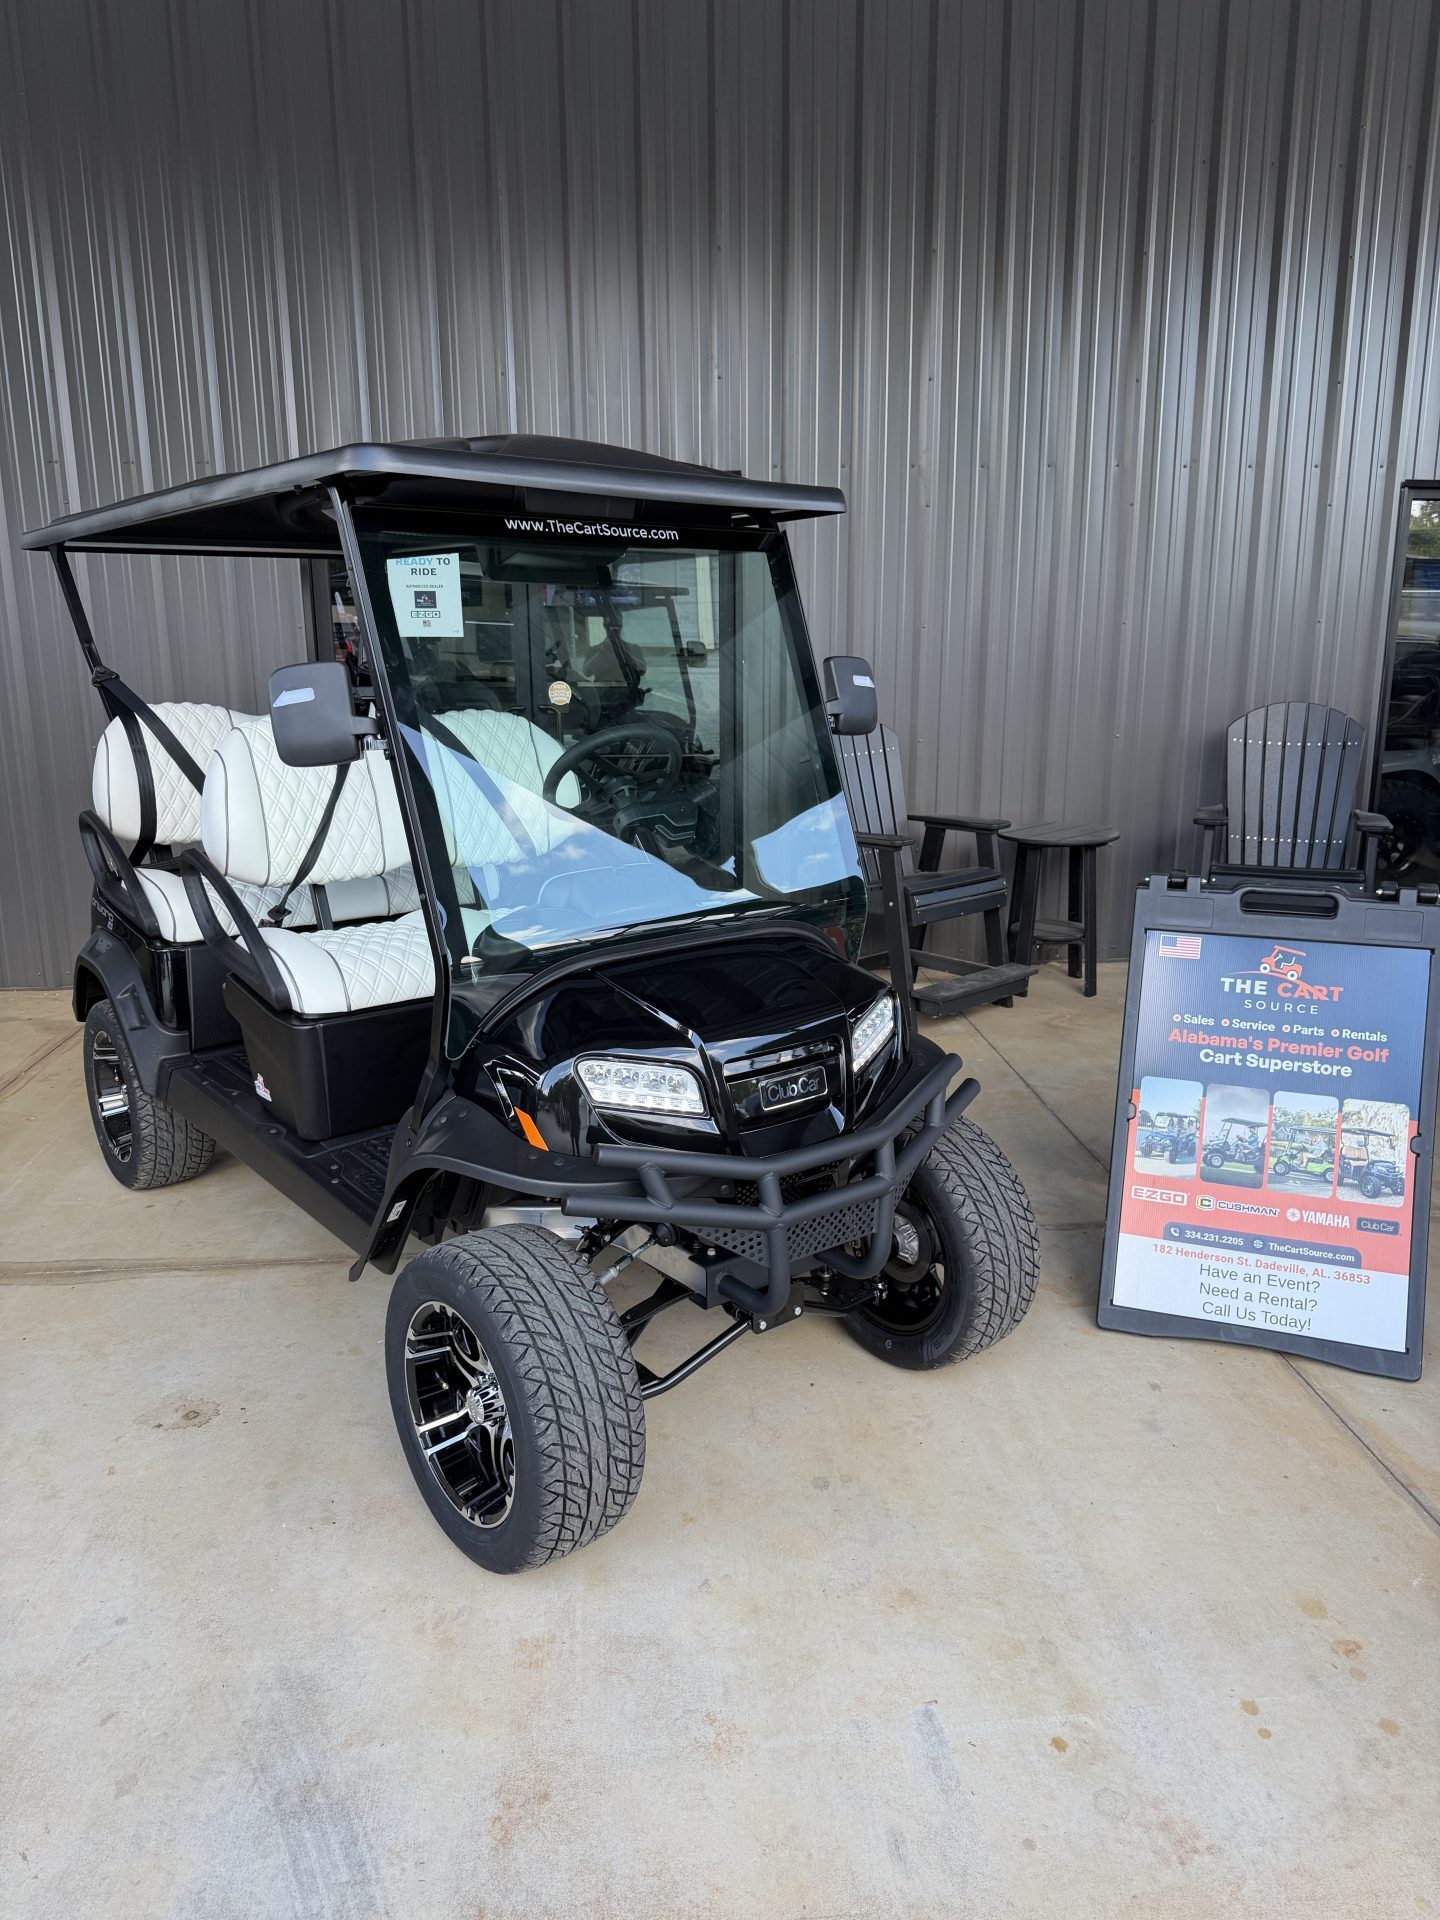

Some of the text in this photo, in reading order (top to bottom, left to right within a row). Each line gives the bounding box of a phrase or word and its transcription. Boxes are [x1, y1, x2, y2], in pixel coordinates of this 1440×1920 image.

[504, 518, 680, 541] www.TheCartSource.com
[395, 557, 451, 566] READY TO
[410, 567, 438, 576] RIDE
[1220, 977, 1344, 1002] THE CART
[1243, 999, 1319, 1015] SOURCE
[1183, 1013, 1388, 1043] Sales Service Parts Rentals
[1168, 1028, 1389, 1063] Alabama's Premier Golf
[1199, 1048, 1353, 1078] Cart Superstore
[767, 1077, 820, 1102] Club Car
[1217, 1201, 1278, 1216] CUSHMAN
[1301, 1210, 1351, 1229] YAMAHA
[1184, 1230, 1244, 1246] 334.231.2205
[1360, 1220, 1395, 1232] Club Car
[1152, 1243, 1371, 1285] 182 Henderson St. Dadeville, AL. 36853
[1268, 1242, 1355, 1262] TheCartSource.com
[1199, 1264, 1321, 1294] Have an Event?
[1199, 1282, 1318, 1312] Need a Rental?
[1202, 1301, 1312, 1332] Call Us Today!
